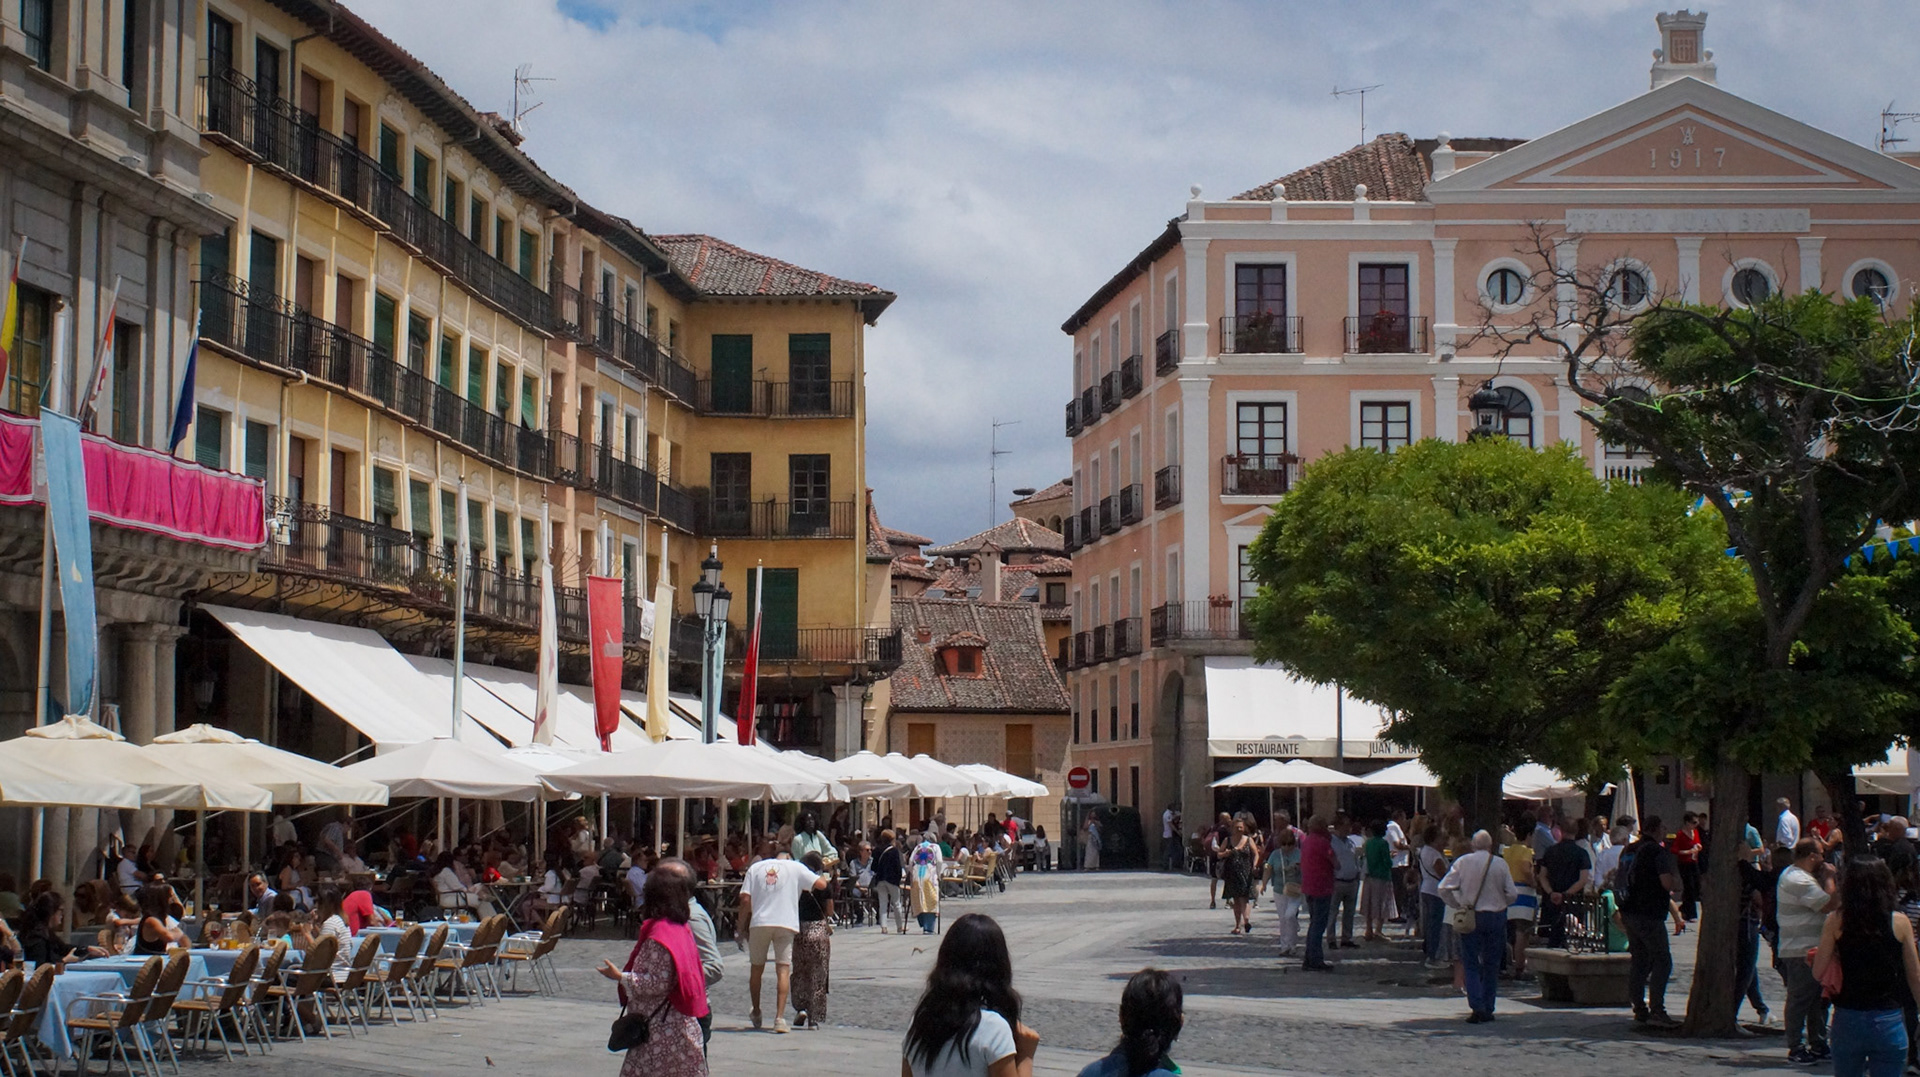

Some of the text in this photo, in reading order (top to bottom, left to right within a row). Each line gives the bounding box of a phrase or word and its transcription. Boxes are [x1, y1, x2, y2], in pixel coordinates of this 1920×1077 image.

[1649, 147, 1726, 169] 1917
[1236, 742, 1300, 755] RESTAURANTE
[1368, 741, 1391, 758] JUAN
